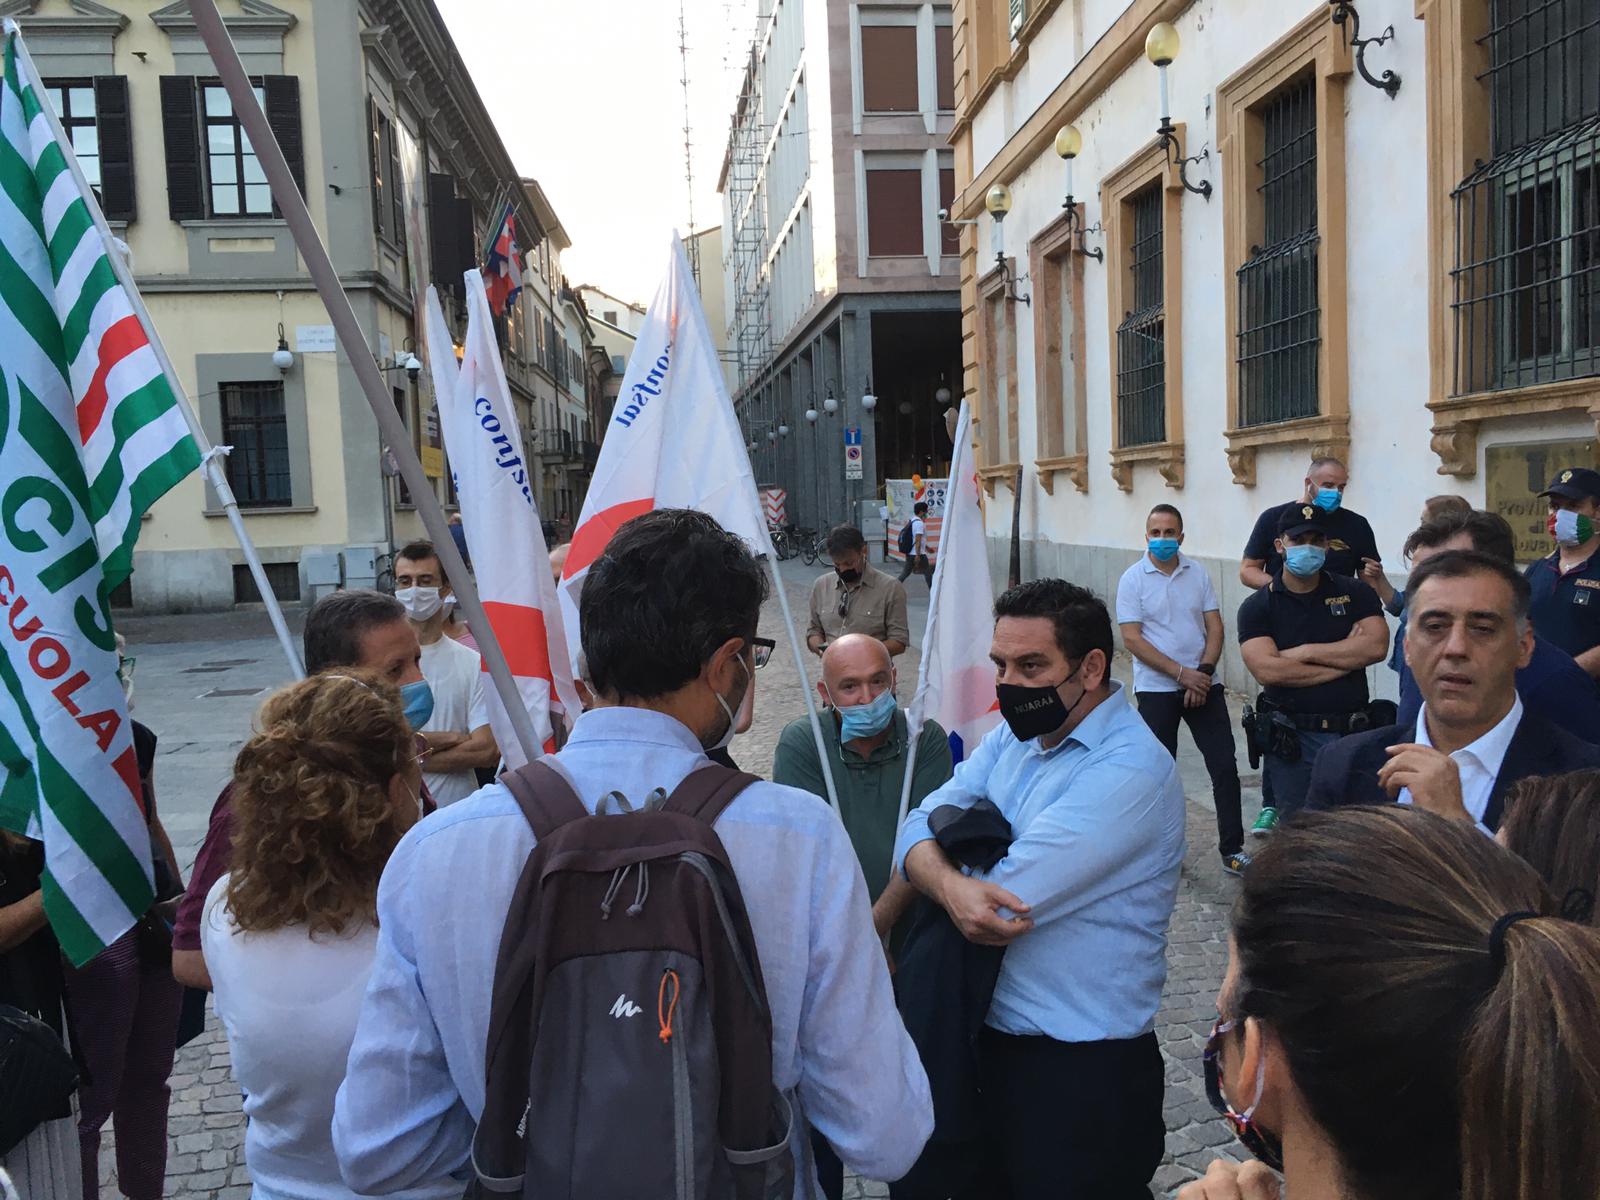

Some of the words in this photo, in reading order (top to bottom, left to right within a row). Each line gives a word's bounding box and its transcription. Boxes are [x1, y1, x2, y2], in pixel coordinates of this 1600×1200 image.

[475, 397, 532, 505] confs
[1499, 500, 1549, 516] Provin
[1, 475, 117, 652] CIS
[0, 564, 122, 753] CUOLA
